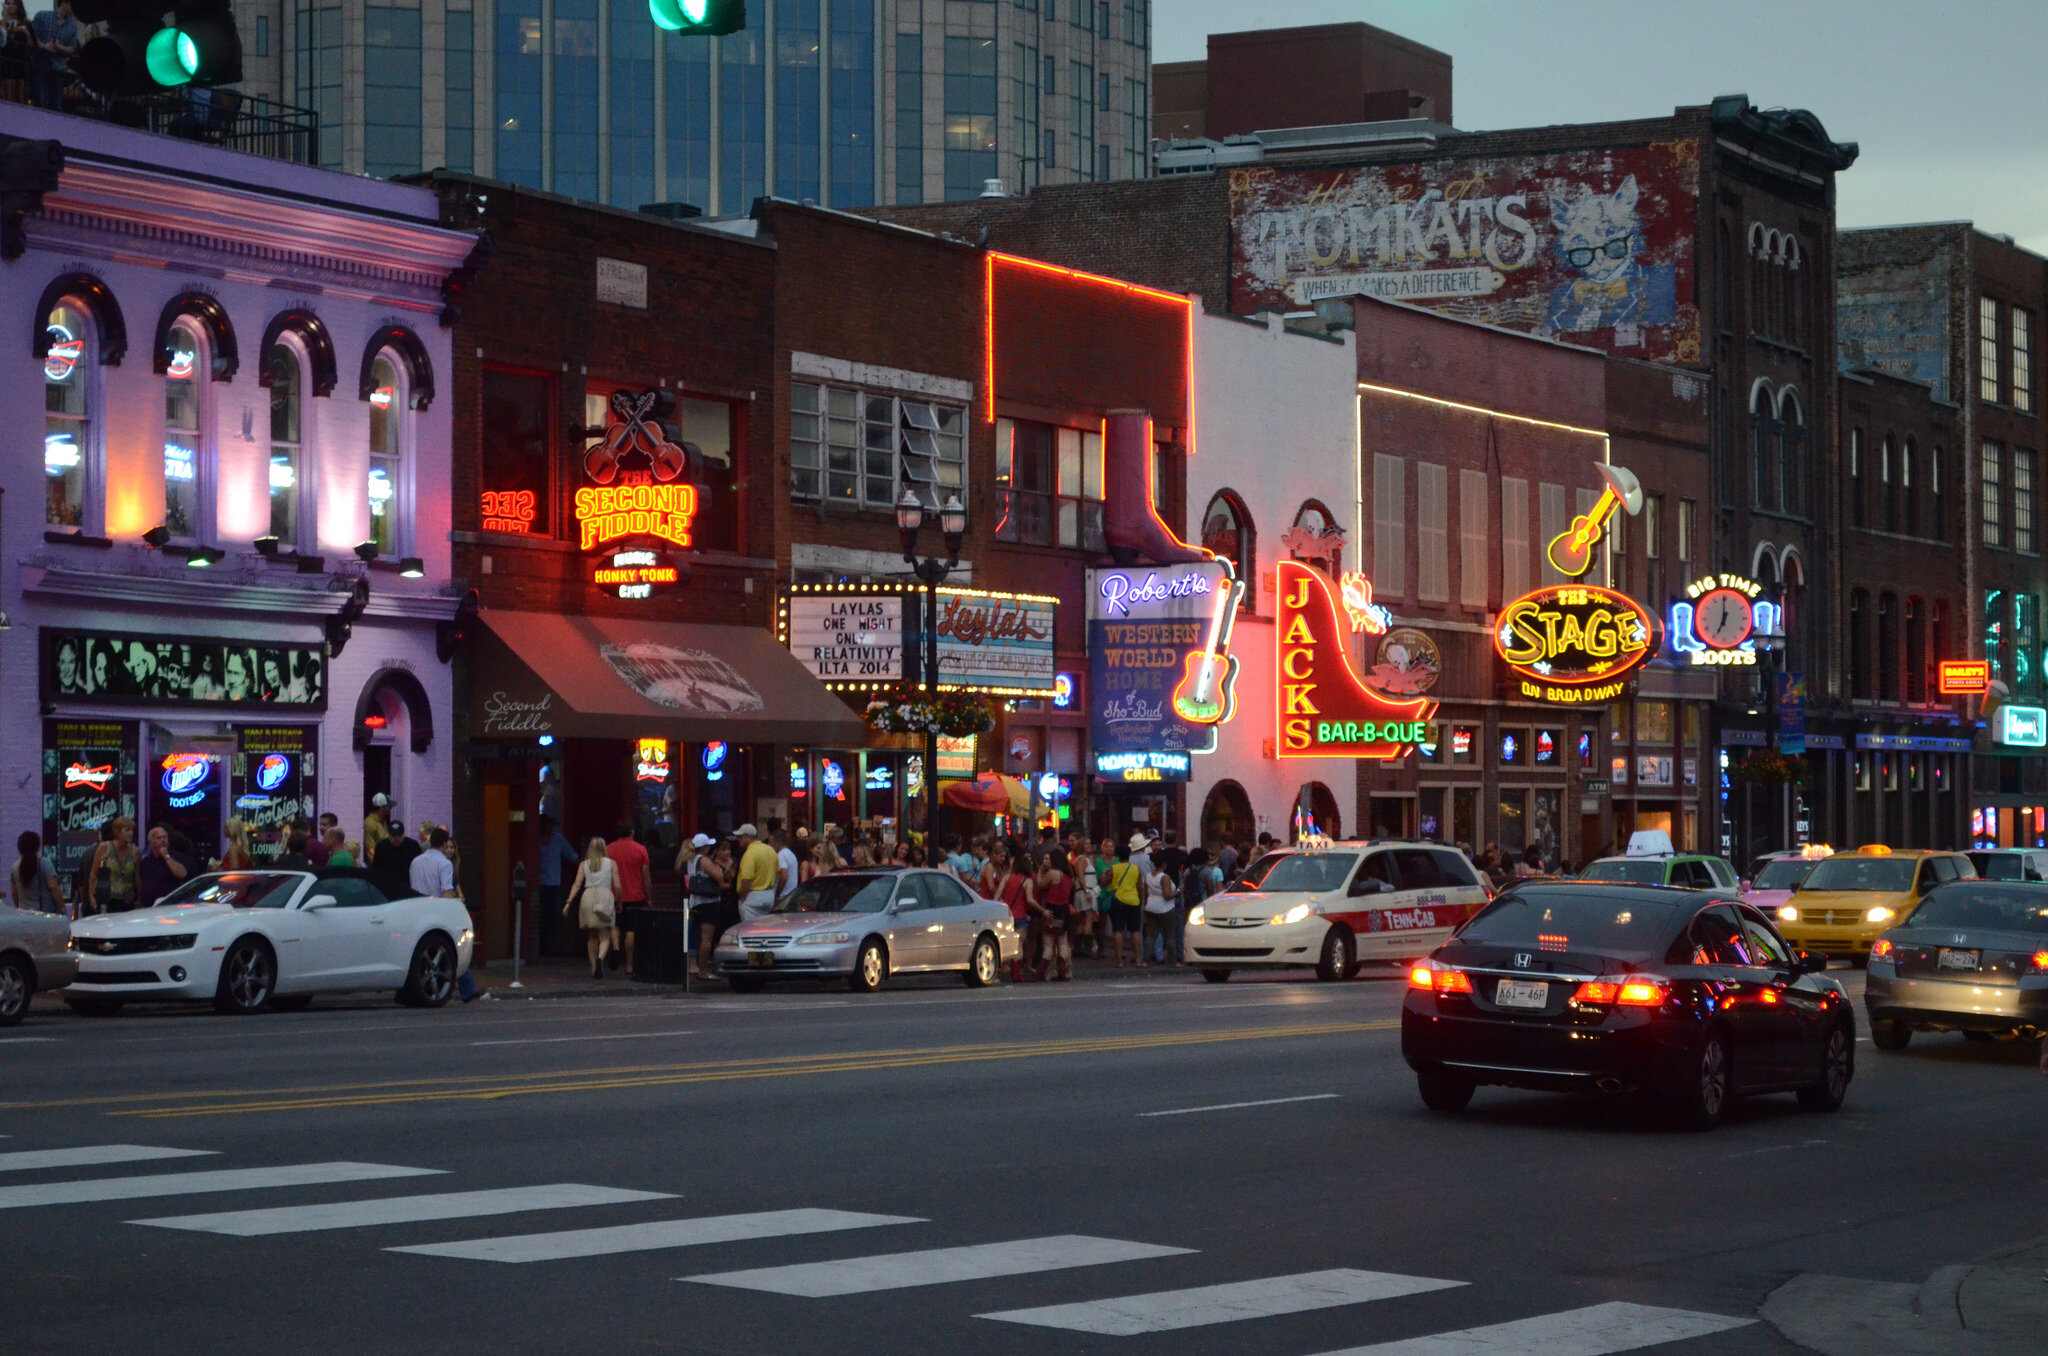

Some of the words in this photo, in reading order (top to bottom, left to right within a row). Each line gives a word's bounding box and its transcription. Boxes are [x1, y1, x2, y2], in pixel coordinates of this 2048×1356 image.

[1259, 189, 1538, 287] TOMKATS
[1412, 271, 1482, 295] DIFFERENCE
[621, 470, 653, 486] THE
[574, 484, 697, 519] SECOND
[580, 511, 692, 550] FIDDLE
[594, 569, 636, 583] HONKY
[639, 568, 678, 582] TONK
[1687, 575, 1717, 599] BIG
[1719, 573, 1762, 598] TIME
[1101, 572, 1211, 617] Robert's
[1557, 589, 1588, 606] THE
[831, 602, 884, 616] LAYLAS
[823, 618, 846, 631] ONE
[859, 617, 894, 631] NIGHT
[937, 595, 1048, 647] Layla's
[836, 632, 866, 645] ONLY
[1103, 622, 1202, 645] WESTERN
[1505, 601, 1645, 665] STAGE
[814, 646, 894, 660] RELATIVITY
[1103, 647, 1177, 669] WORLD
[1283, 577, 1321, 750] JACKS
[1691, 649, 1757, 666] BOOTS
[819, 661, 849, 675] ILTA
[859, 661, 890, 675] 2014
[1945, 667, 1985, 677] BAILEY'S
[1104, 670, 1163, 691] HOME
[1125, 689, 1137, 705] of
[1521, 681, 1541, 699] ON
[1547, 682, 1624, 702] BROADWAY
[484, 691, 551, 714] Second
[484, 710, 551, 733] Fiddle
[1318, 721, 1426, 743] BAR-B-QUE
[1097, 753, 1148, 771] HONKY
[1148, 751, 1189, 771] TONK
[1123, 767, 1162, 781] GRILL
[1588, 783, 1607, 793] ATM
[1298, 840, 1329, 850] TAXI
